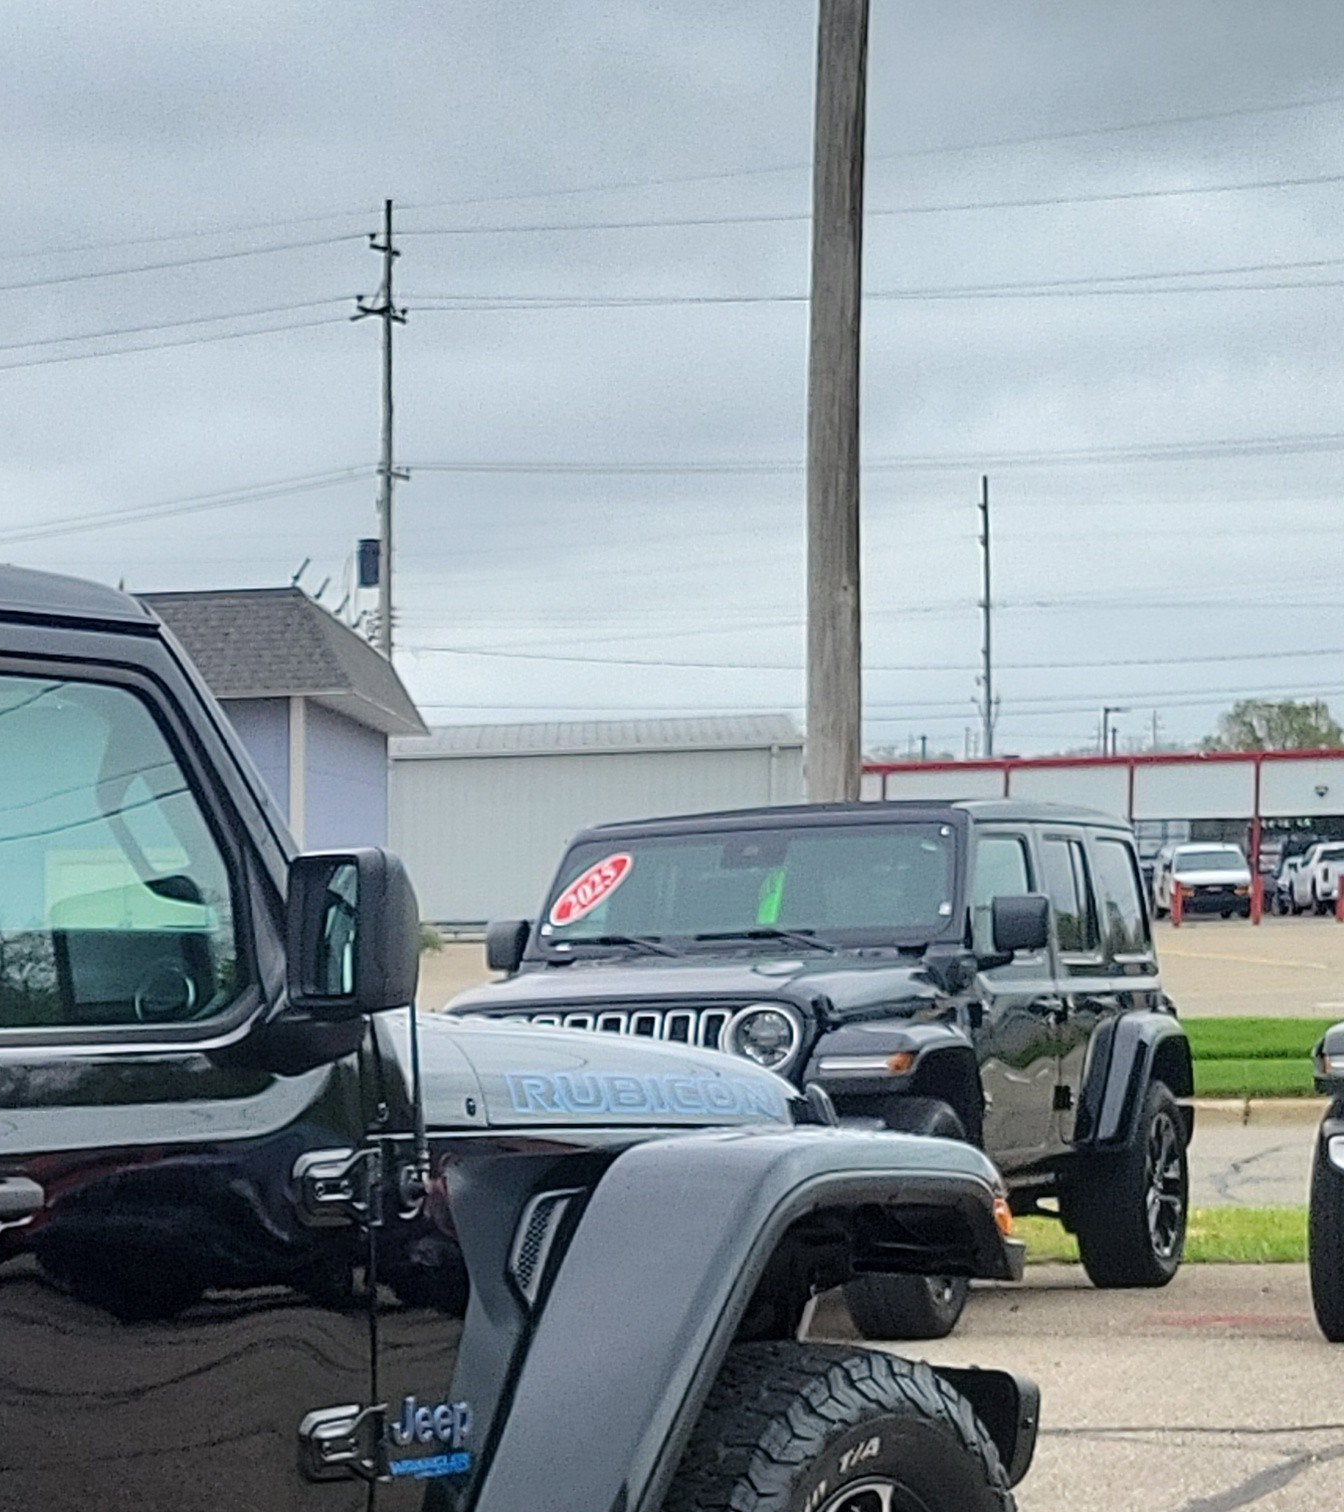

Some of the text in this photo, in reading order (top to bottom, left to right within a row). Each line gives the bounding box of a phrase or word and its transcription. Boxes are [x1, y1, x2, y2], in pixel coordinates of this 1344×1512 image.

[566, 863, 619, 914] 2025
[505, 1072, 784, 1117] RUBICON
[391, 1396, 471, 1448] Jeep
[838, 1435, 882, 1475] T/A
